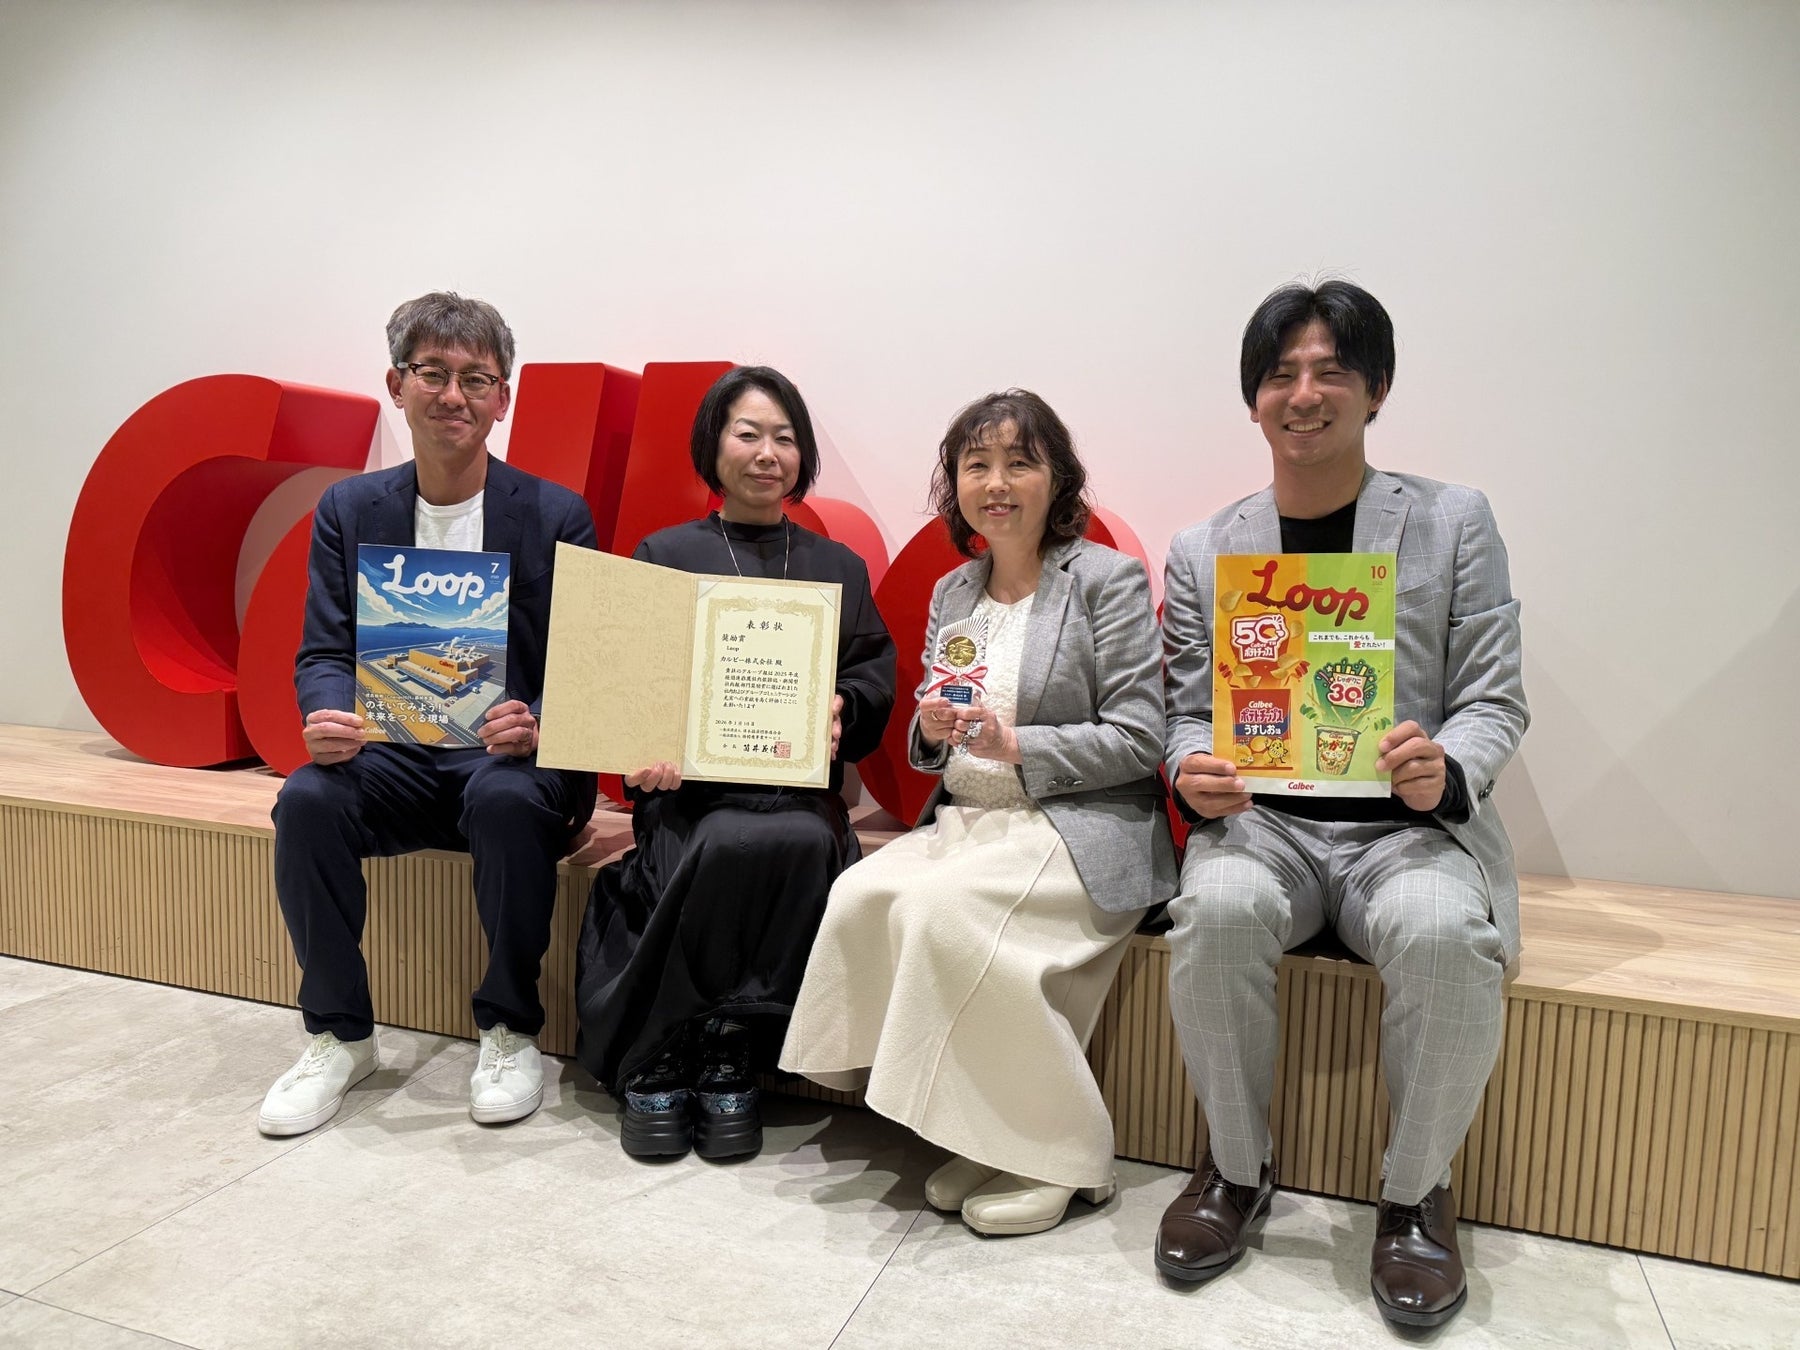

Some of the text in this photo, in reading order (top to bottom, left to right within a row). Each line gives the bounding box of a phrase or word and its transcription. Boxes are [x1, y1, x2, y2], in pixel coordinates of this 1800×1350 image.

[491, 563, 499, 574] 7
[1371, 565, 1387, 579] 10
[382, 554, 485, 605] Loop
[1247, 560, 1369, 627] Loop
[746, 619, 784, 631] 表彰状
[722, 633, 746, 642] 奨励賞
[1353, 640, 1386, 649] 愛されたい！
[720, 656, 773, 666] カルビー株式会社
[1248, 701, 1273, 709] Calbee
[365, 711, 449, 724] 未来をつくる現場
[1240, 707, 1284, 723] ポテトチップス
[1287, 781, 1315, 791] Calbee
